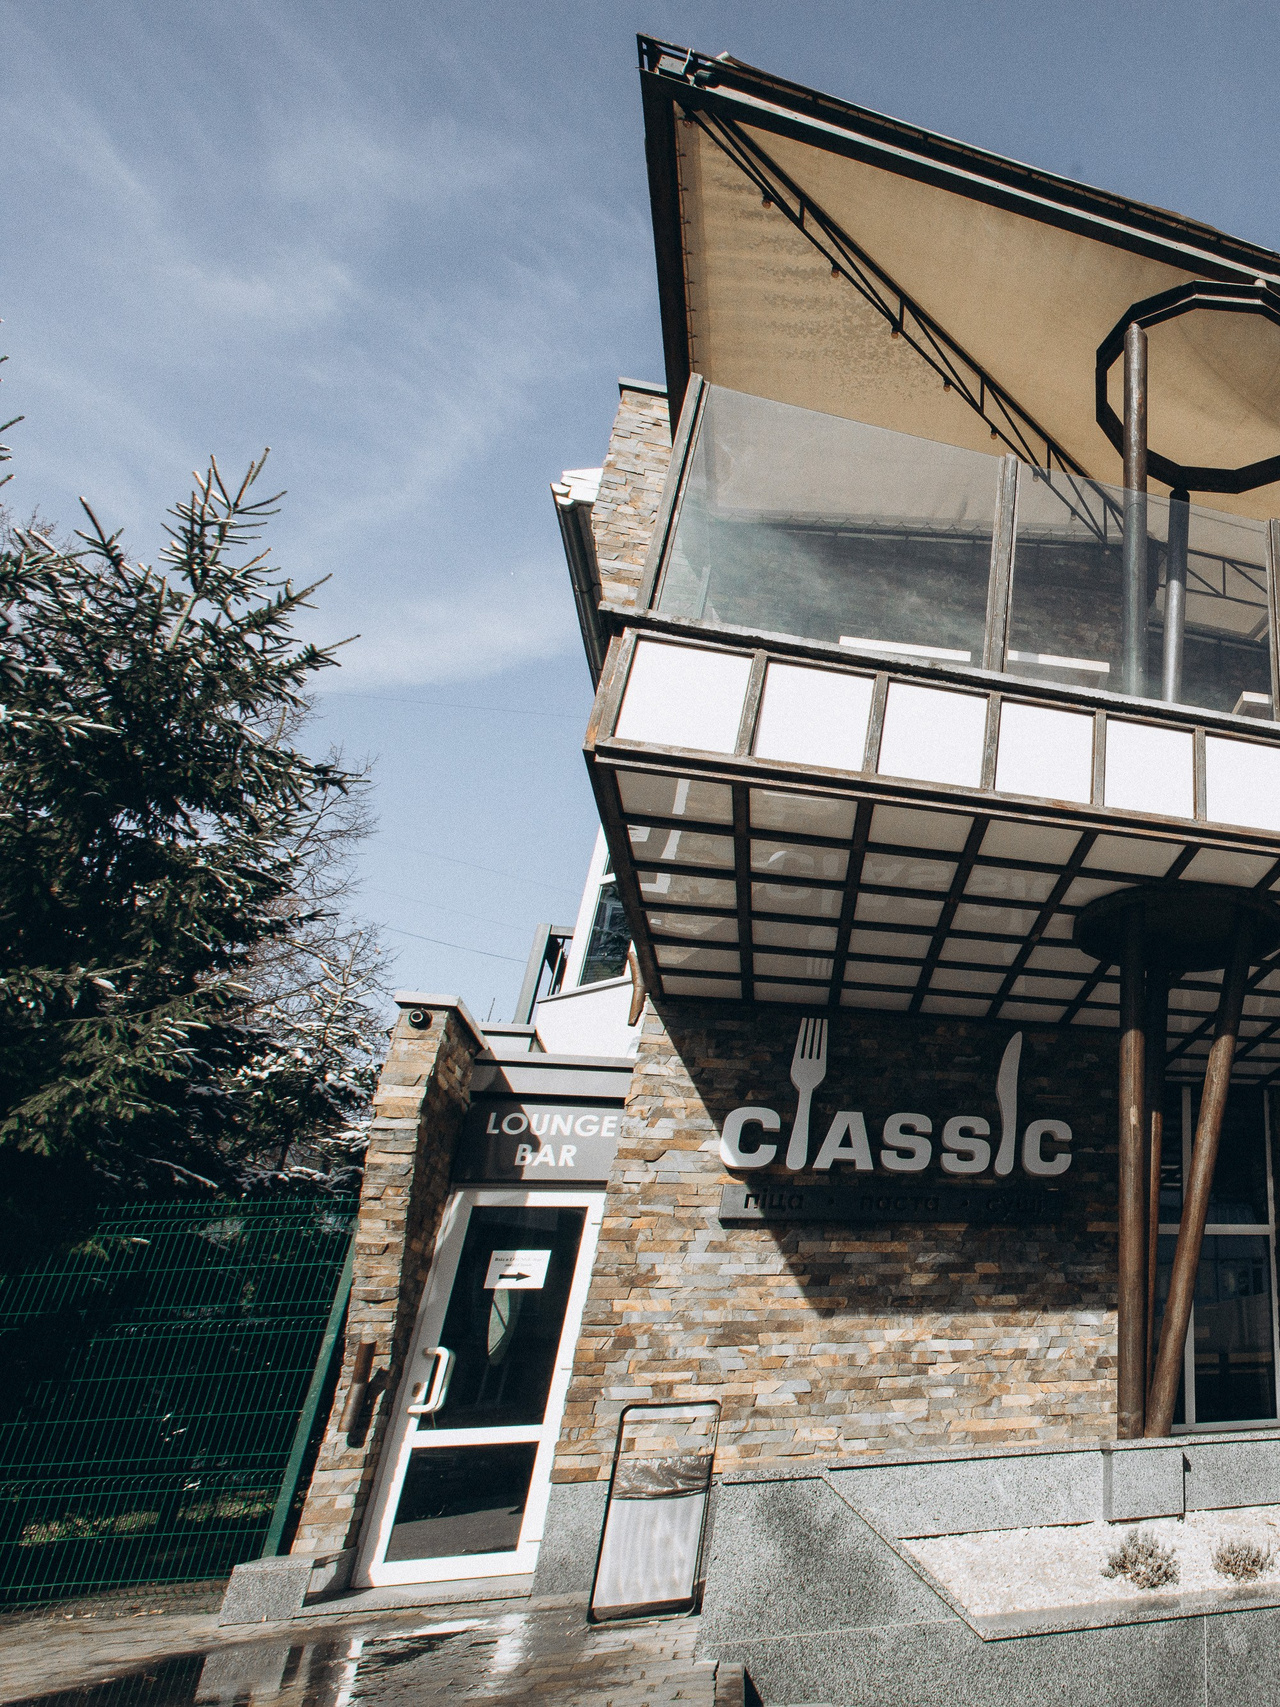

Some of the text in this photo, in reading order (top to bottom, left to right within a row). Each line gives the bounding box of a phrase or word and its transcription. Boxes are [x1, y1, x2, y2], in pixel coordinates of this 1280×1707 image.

[486, 1112, 618, 1137] LOUNGE
[514, 1144, 577, 1167] BAR
[744, 1189, 804, 1212] піца
[860, 1194, 940, 1211] паста
